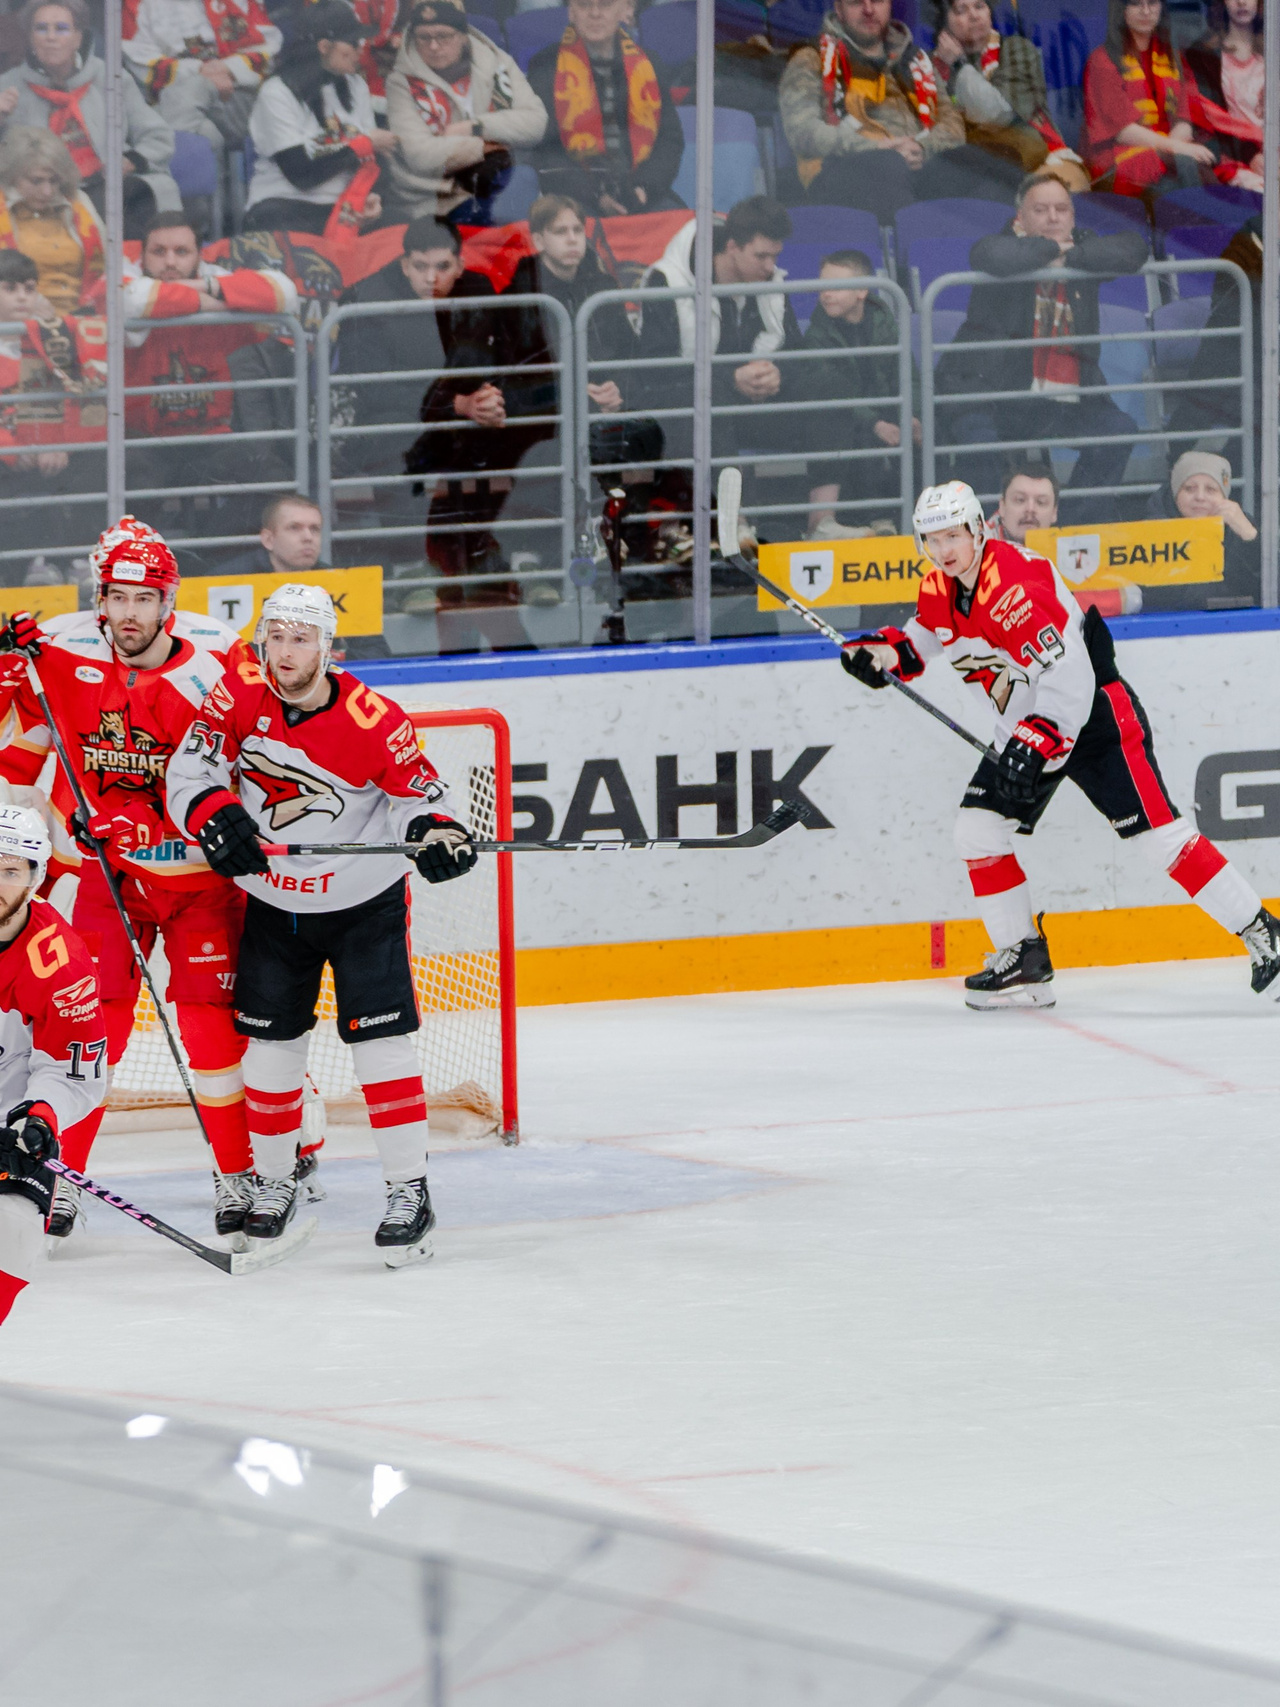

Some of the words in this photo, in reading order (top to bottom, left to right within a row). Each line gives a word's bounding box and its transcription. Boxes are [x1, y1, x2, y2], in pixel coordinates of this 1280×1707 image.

[1108, 540, 1191, 567] БАНК
[114, 566, 144, 578] согаз
[841, 558, 927, 583] БАНК
[285, 586, 305, 597] 51
[1021, 622, 1066, 669] 19
[184, 720, 227, 768] 51
[81, 745, 170, 780] REDSTAR
[472, 744, 836, 842] БАНК
[0, 808, 23, 821] 17
[128, 841, 188, 861] BUR
[256, 870, 336, 895] NBET
[26, 923, 70, 980] G
[66, 1036, 108, 1082] 17
[43, 1157, 150, 1219] SOYUZ
